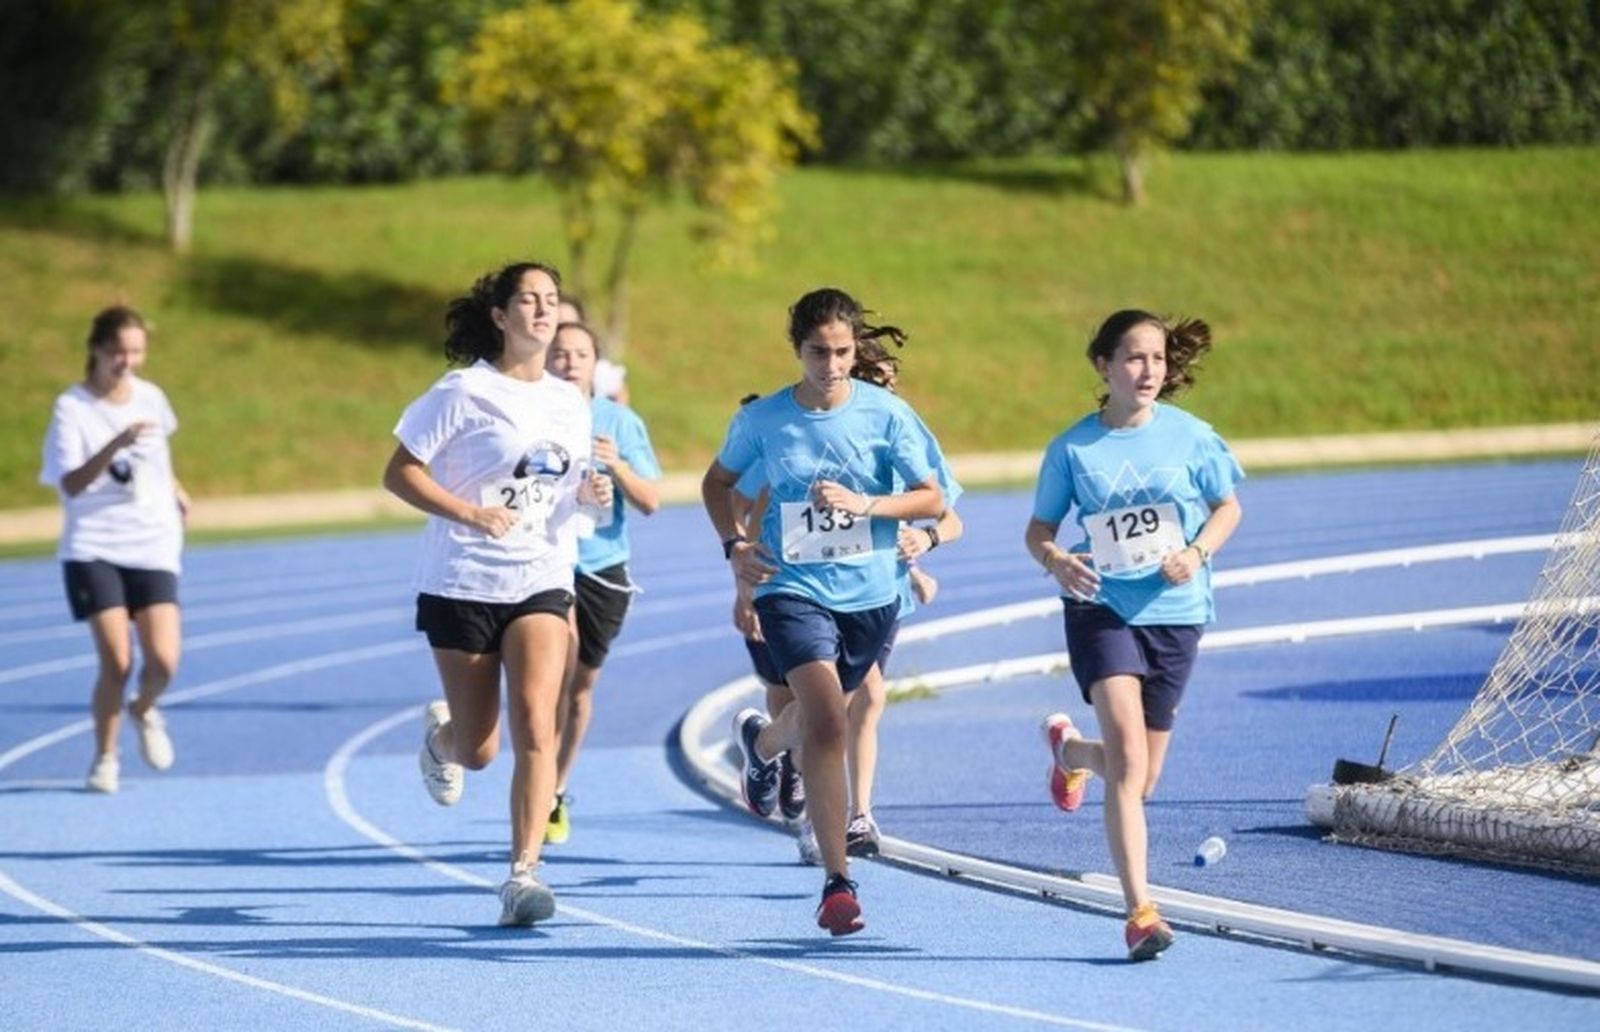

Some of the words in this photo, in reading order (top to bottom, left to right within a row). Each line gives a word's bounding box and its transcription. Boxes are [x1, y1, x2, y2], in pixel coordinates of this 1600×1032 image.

[500, 479, 542, 510] 213
[801, 506, 854, 533] 133
[1106, 507, 1160, 542] 129
